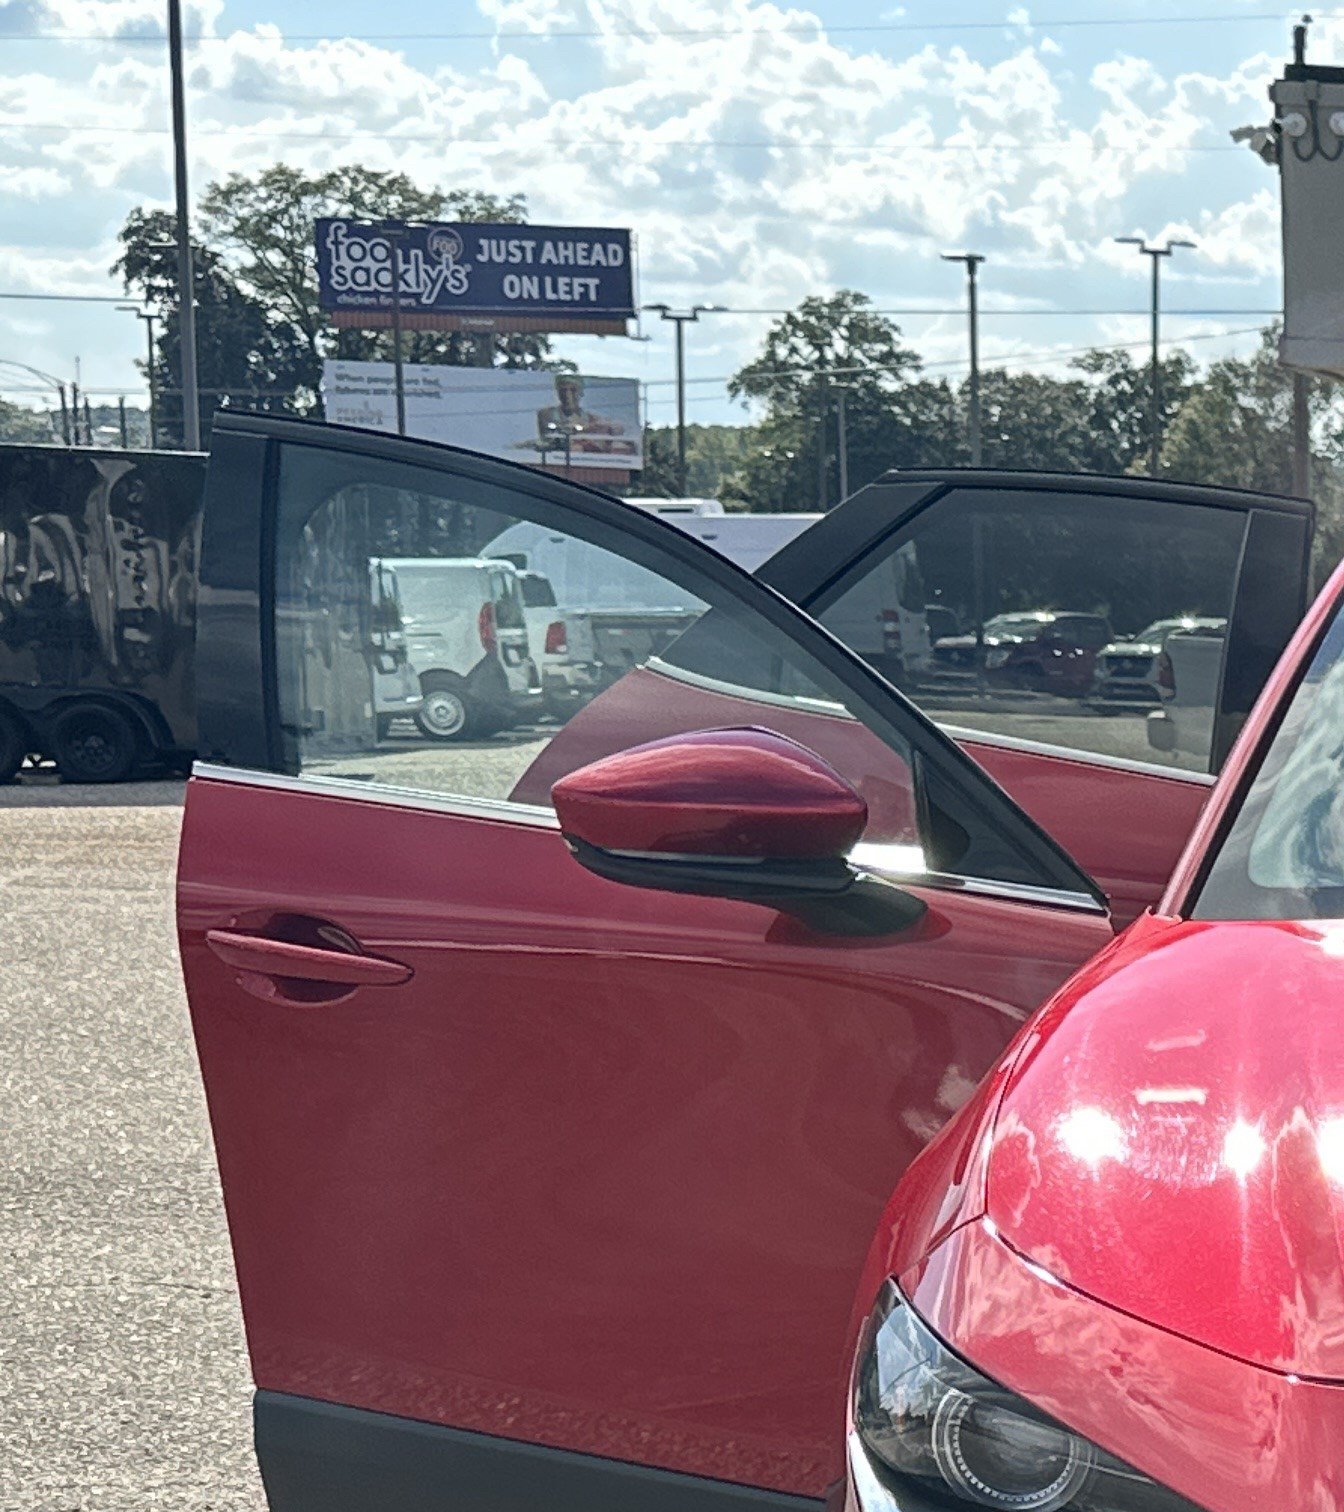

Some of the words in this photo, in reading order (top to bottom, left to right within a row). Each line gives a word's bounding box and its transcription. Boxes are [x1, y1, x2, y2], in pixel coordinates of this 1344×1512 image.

[326, 221, 394, 263] foo
[475, 238, 536, 264] JUST
[539, 240, 624, 267] AHEAD
[503, 274, 540, 299] ON
[544, 276, 601, 301] LEFT
